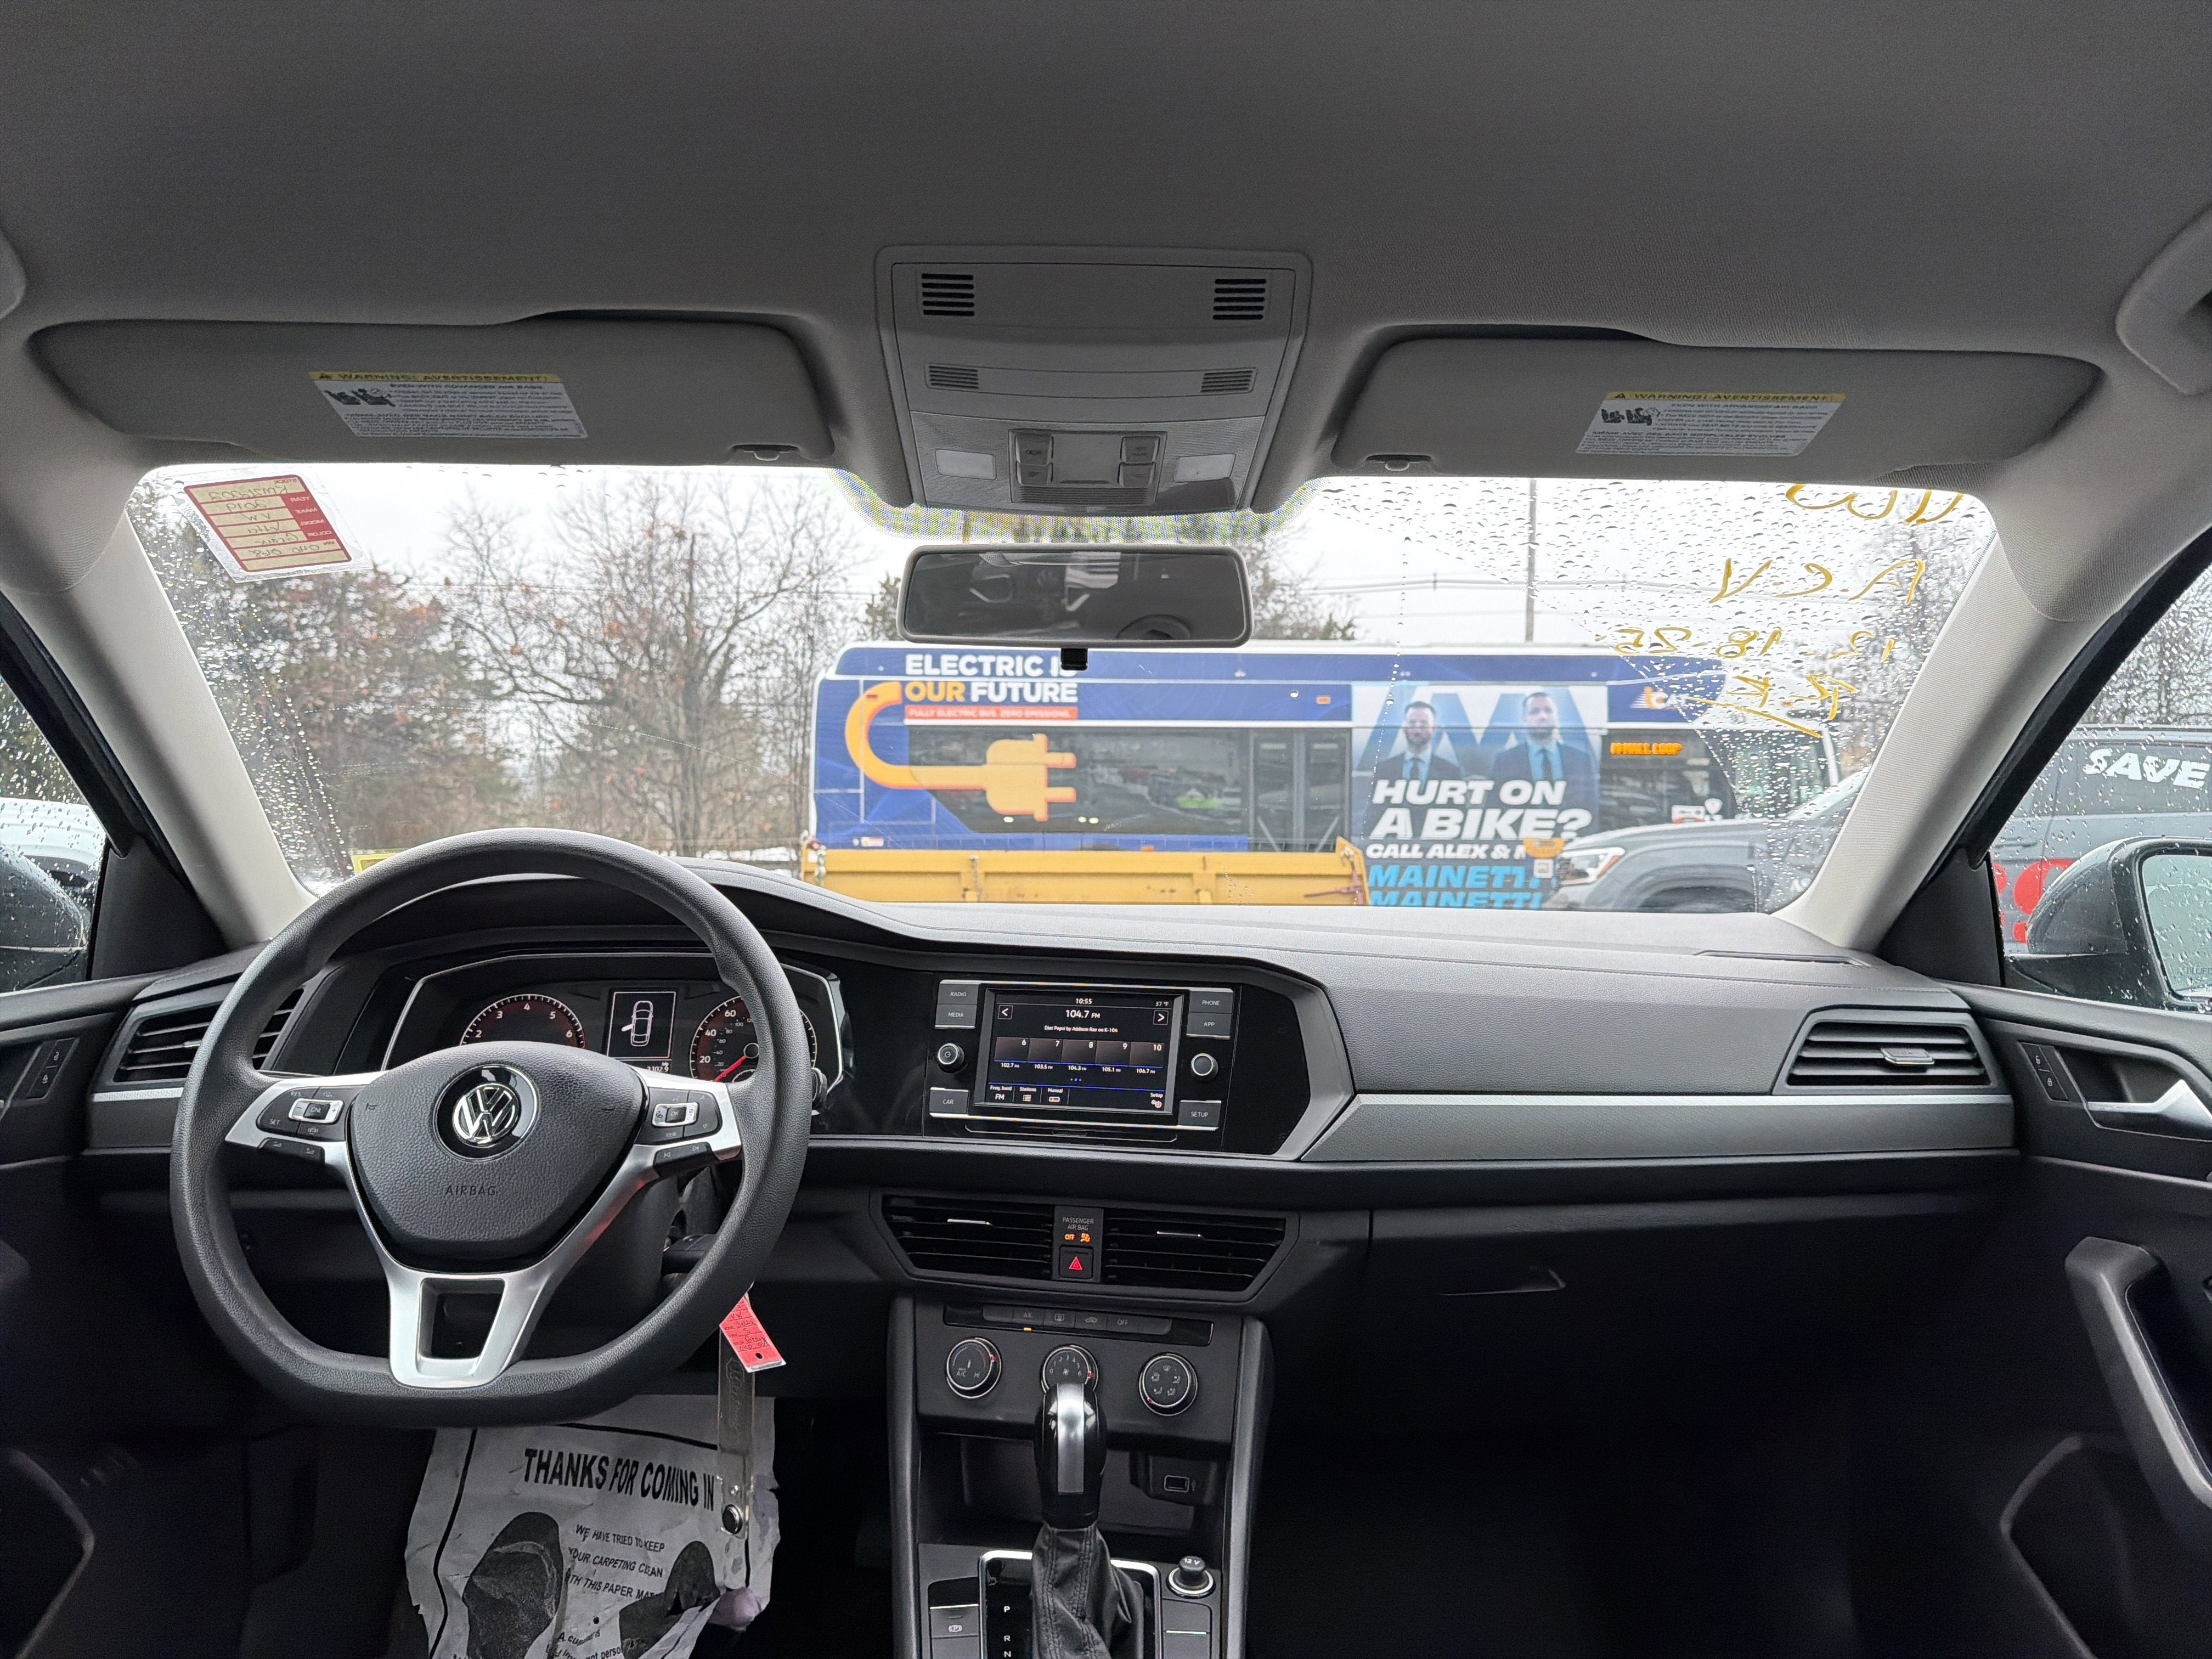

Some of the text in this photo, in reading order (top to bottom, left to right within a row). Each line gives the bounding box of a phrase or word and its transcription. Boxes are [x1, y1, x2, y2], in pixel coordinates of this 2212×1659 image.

[905, 654, 1043, 676] ELECTRIC
[905, 681, 1078, 703] OUR FUTURE
[2084, 748, 2211, 789] SAVE
[1372, 780, 1567, 805] HURT ON
[1369, 808, 1592, 842] A BIKE?
[1366, 844, 1424, 859] CALL
[1426, 844, 1489, 859] ALEX
[1490, 845, 1511, 860] &
[523, 1003, 531, 1011] 4
[496, 1011, 503, 1019] 3
[549, 1011, 556, 1019] 5
[724, 1009, 736, 1018] 60
[1065, 1009, 1091, 1019] 104.7
[475, 1030, 482, 1038] 2
[566, 1029, 573, 1038] 6
[705, 1029, 716, 1037] 40
[445, 1185, 496, 1197] AIRBAG
[524, 1448, 609, 1489] THANKS
[608, 1458, 639, 1496] FOR
[641, 1462, 699, 1506] COMING
[612, 1533, 633, 1546] TRIED
[644, 1540, 665, 1553] KEEP
[568, 1547, 591, 1563] YOUR
[592, 1555, 636, 1571] CARPETING
[583, 1578, 603, 1591] THIS
[602, 1582, 634, 1598] PAPER
[1004, 1605, 1011, 1613] P
[557, 1632, 565, 1641] A
[1004, 1634, 1011, 1643] R
[601, 1646, 621, 1659] perso
